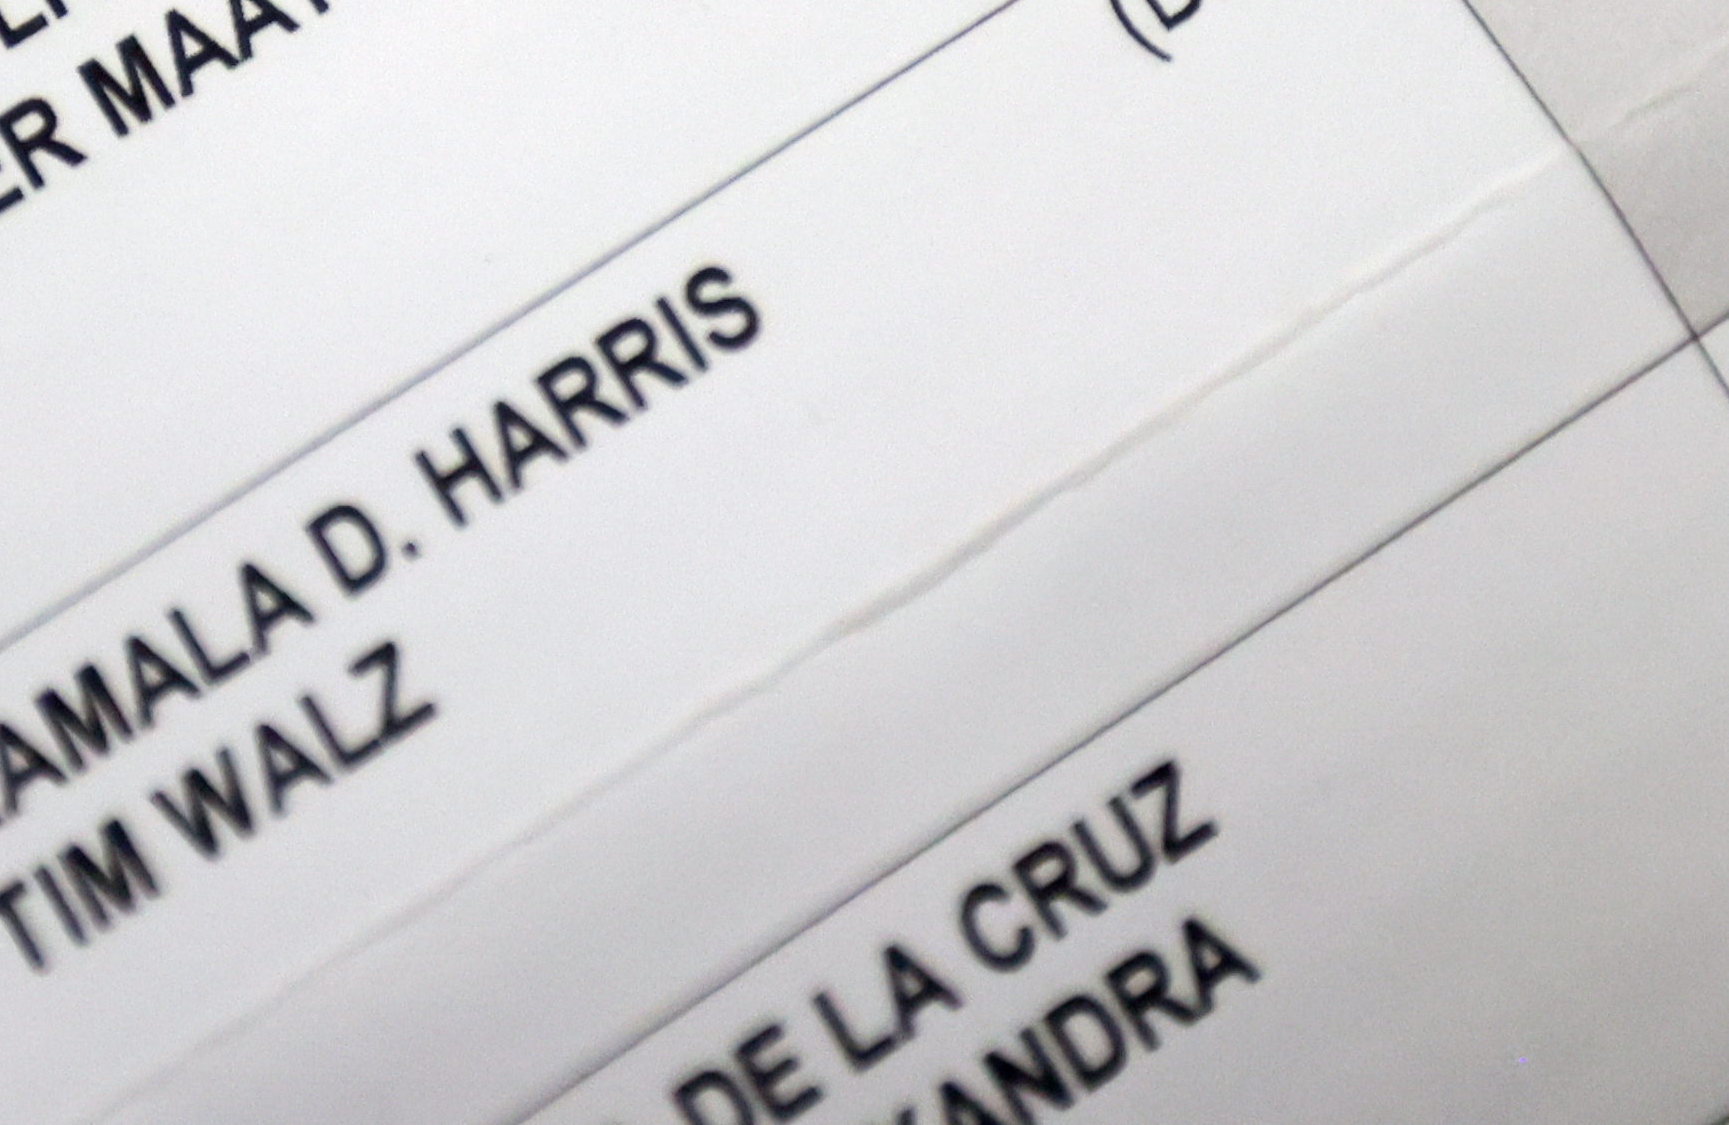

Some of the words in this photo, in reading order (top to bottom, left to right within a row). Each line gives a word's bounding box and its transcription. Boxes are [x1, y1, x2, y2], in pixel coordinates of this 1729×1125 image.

[303, 501, 423, 597] D.
[413, 264, 762, 528] HARRIS
[149, 639, 438, 860] WALZ
[669, 1021, 825, 1125] DE
[811, 942, 963, 1072] LA
[957, 757, 1219, 974] CRUZ
[877, 915, 1262, 1125] ANDRA
